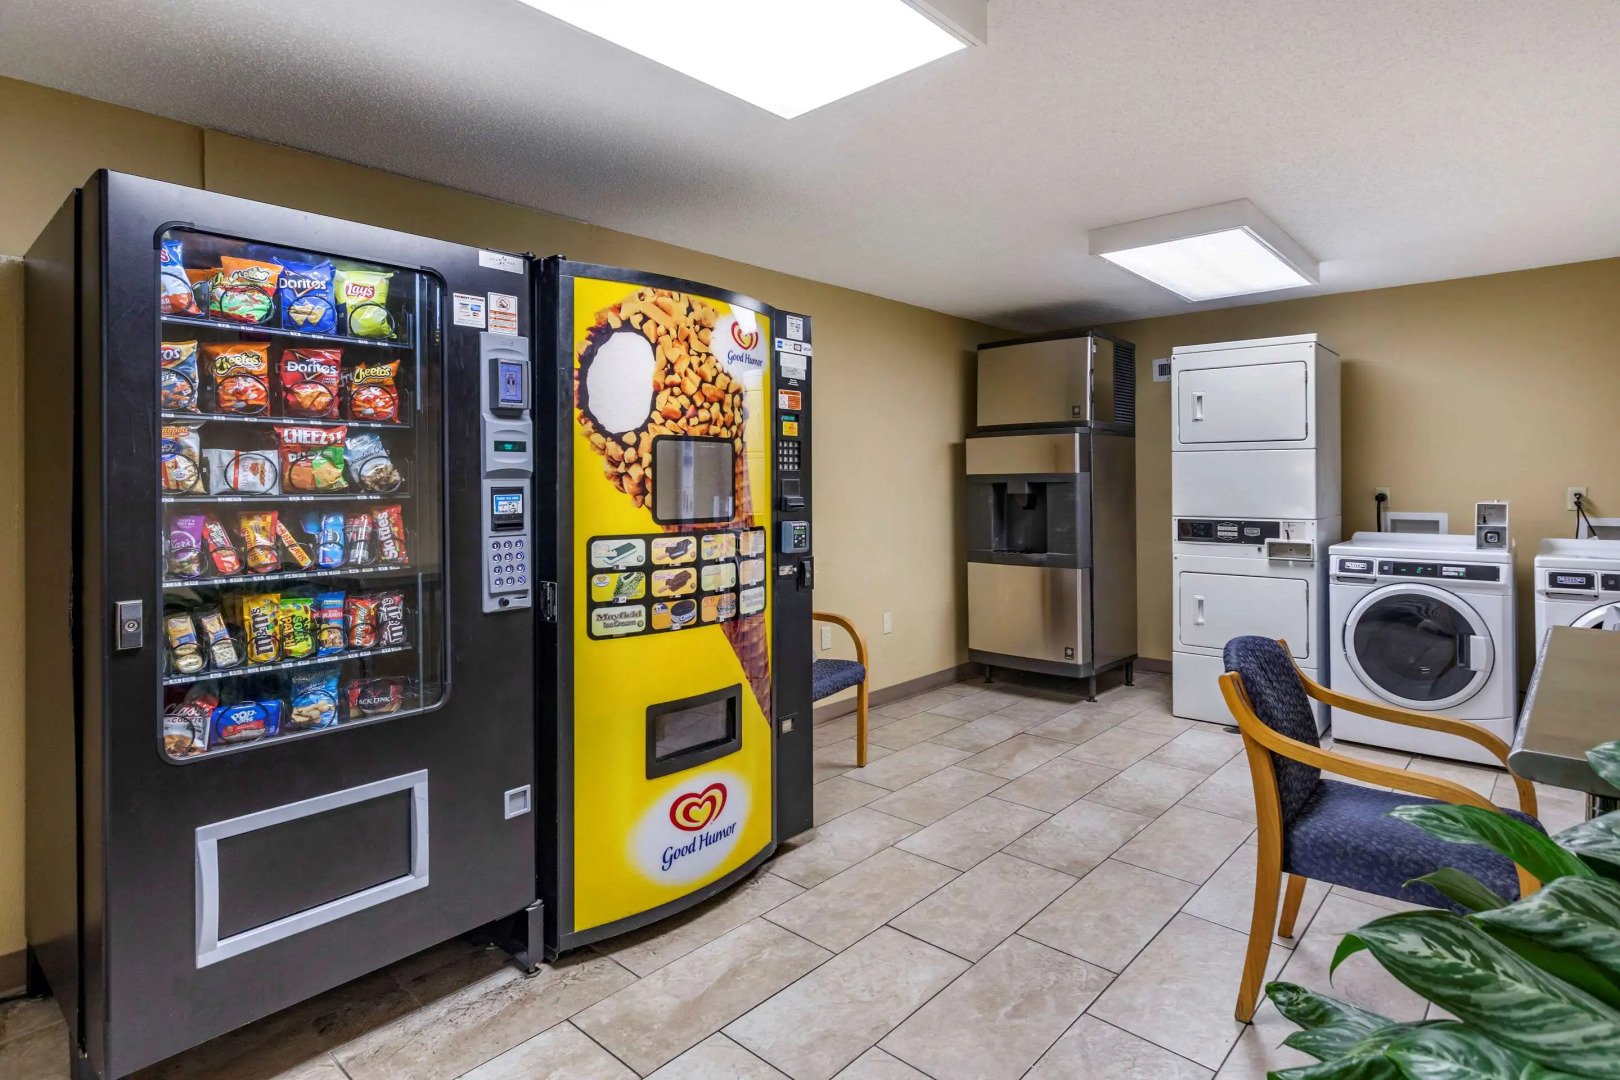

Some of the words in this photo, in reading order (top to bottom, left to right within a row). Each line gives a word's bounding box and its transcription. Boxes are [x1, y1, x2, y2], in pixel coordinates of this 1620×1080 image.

[279, 277, 327, 290] Doritos
[216, 352, 261, 375] Cheetos
[727, 349, 744, 365] Good
[744, 354, 764, 367] Humor
[287, 361, 338, 375] Doritos
[354, 366, 391, 384] Cheetos
[1558, 576, 1585, 584] MAYTAG
[293, 615, 306, 643] SOUR
[661, 836, 697, 872] Good
[698, 822, 737, 851] Humor
